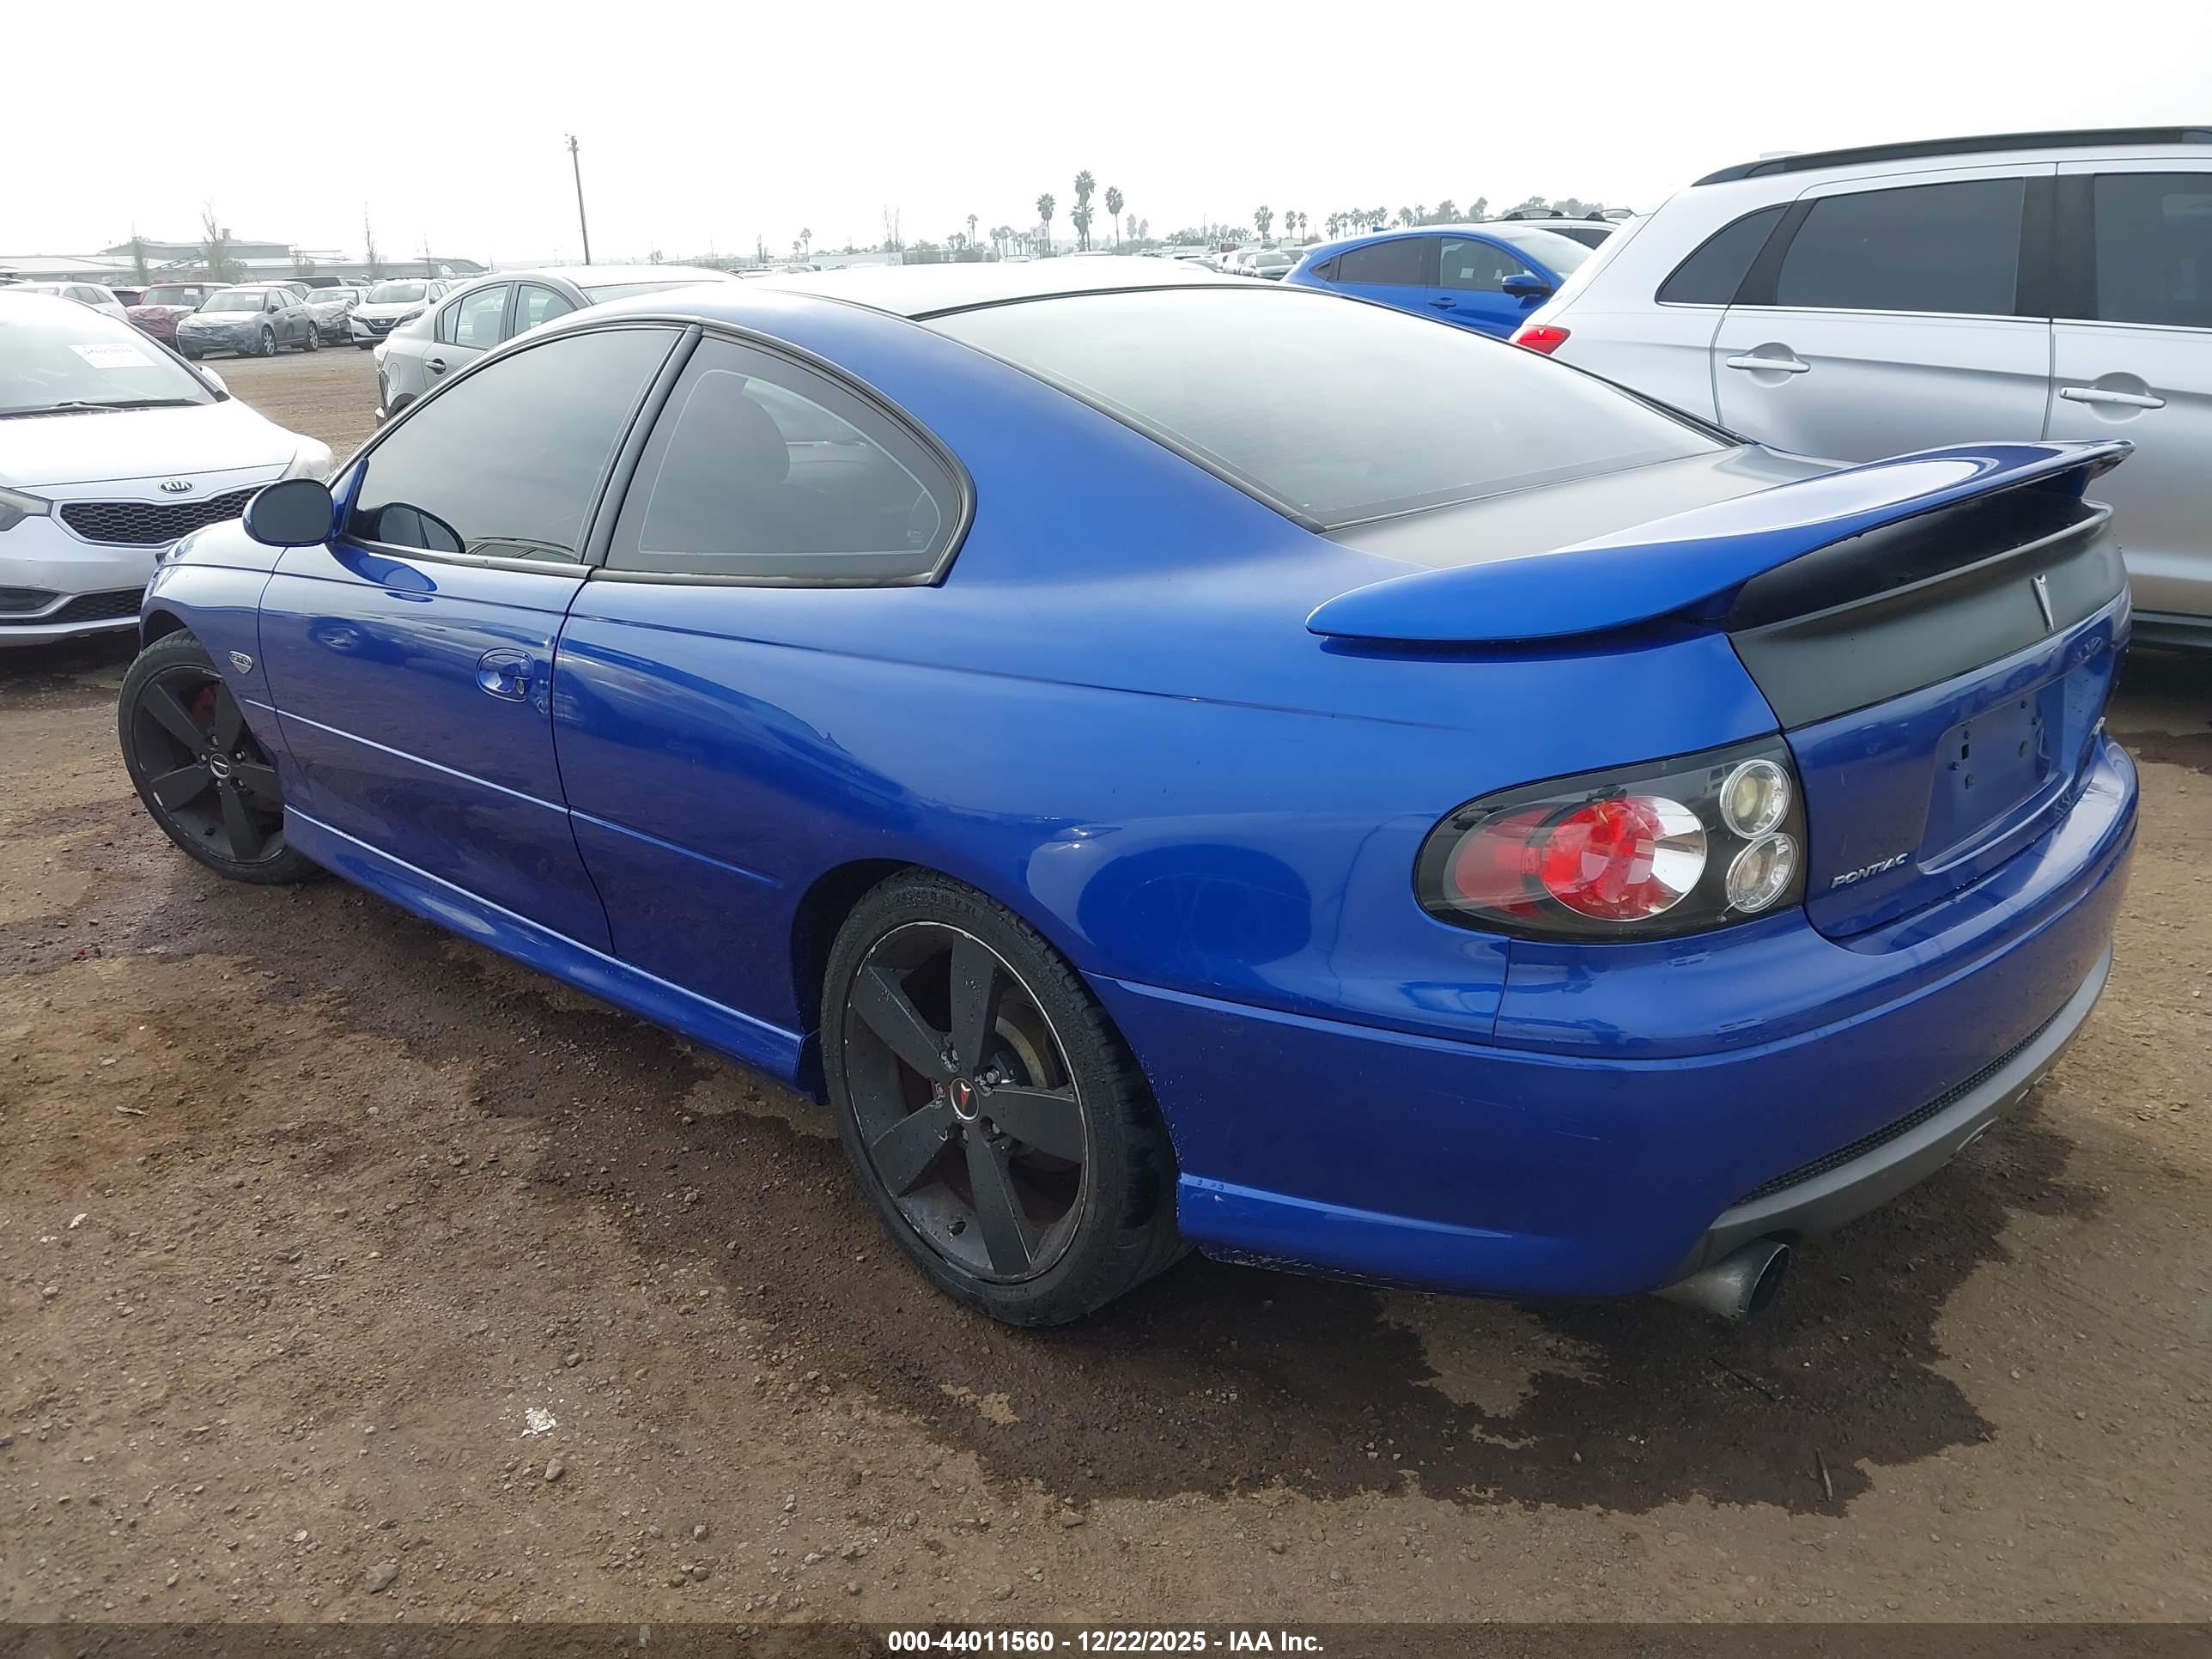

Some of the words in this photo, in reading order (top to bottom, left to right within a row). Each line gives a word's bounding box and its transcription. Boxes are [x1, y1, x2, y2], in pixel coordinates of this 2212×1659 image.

[163, 481, 191, 490] KIA
[231, 653, 250, 665] GTO
[1831, 853, 1908, 889] PONTIAC
